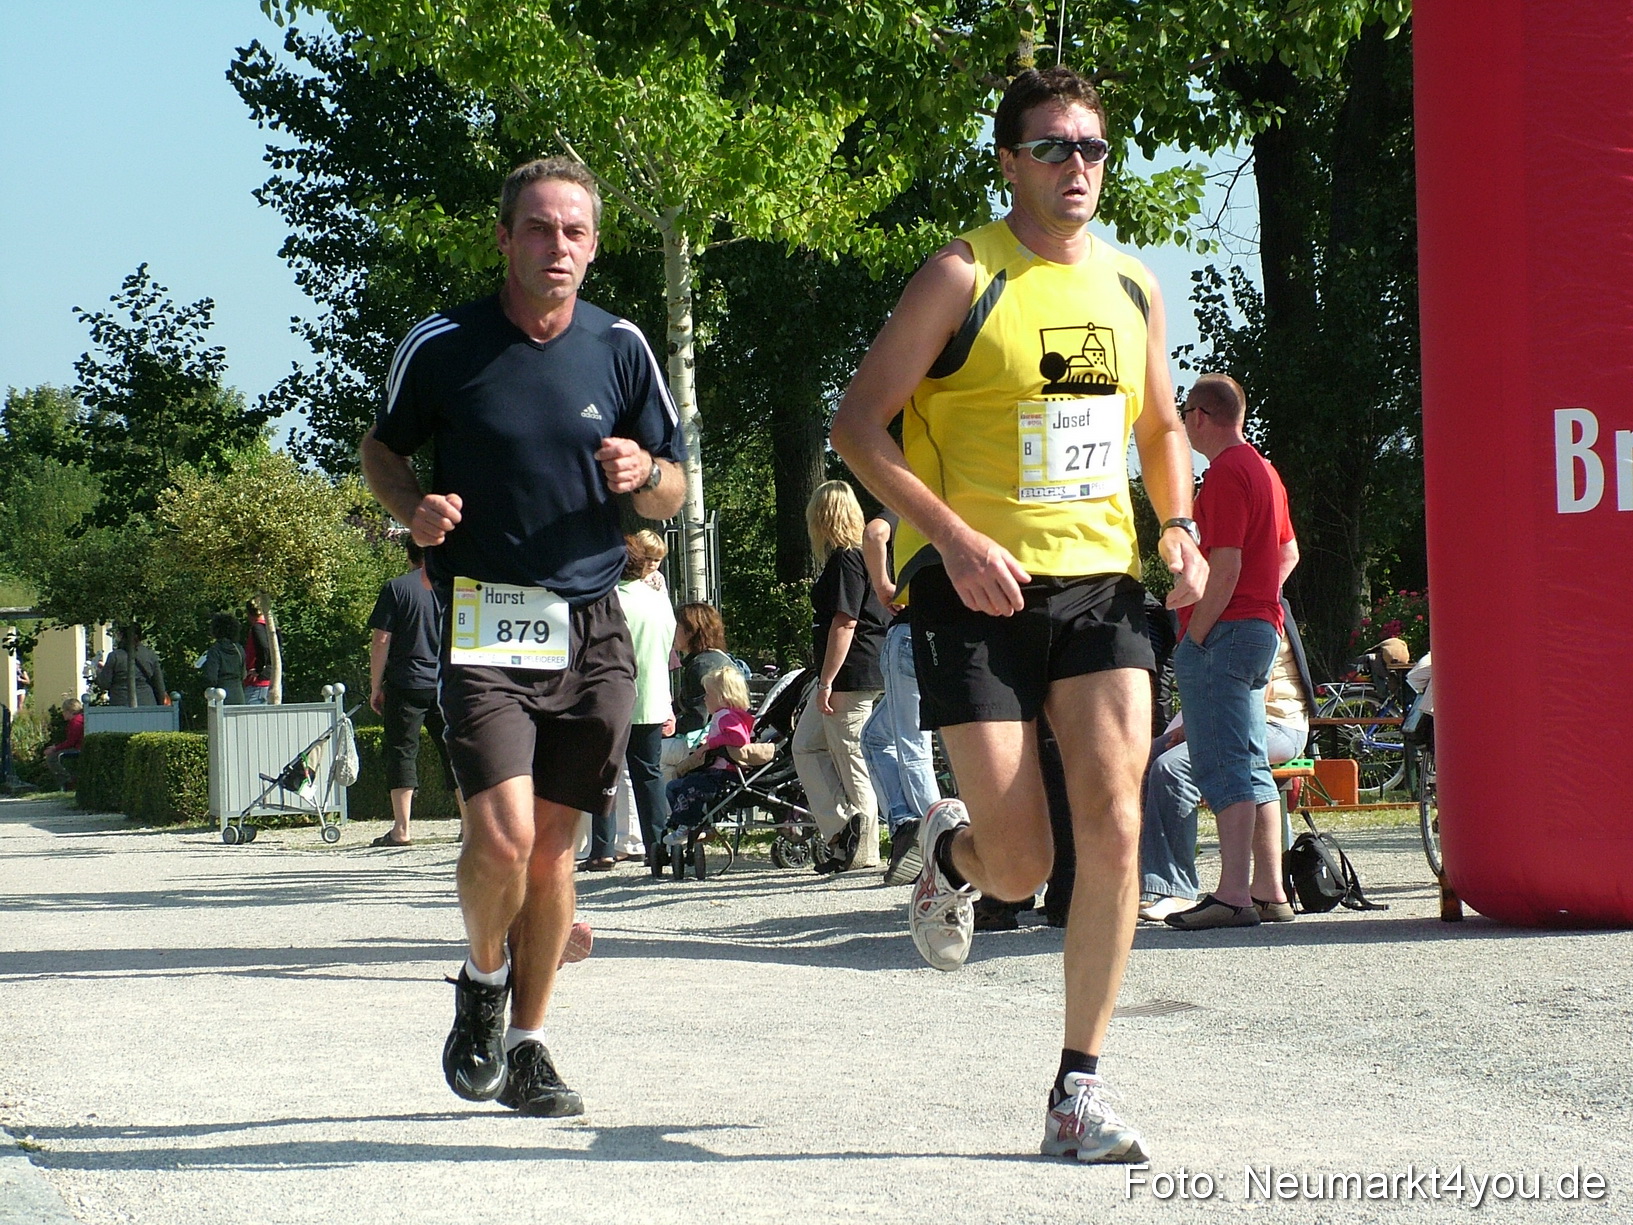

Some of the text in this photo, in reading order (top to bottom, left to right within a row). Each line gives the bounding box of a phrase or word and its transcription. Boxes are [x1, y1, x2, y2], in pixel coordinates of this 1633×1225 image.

[1053, 408, 1091, 429] Josef
[1024, 441, 1032, 456] B
[1065, 441, 1112, 471] 277
[485, 587, 525, 605] Horst
[458, 612, 466, 625] B
[496, 619, 550, 644] 879
